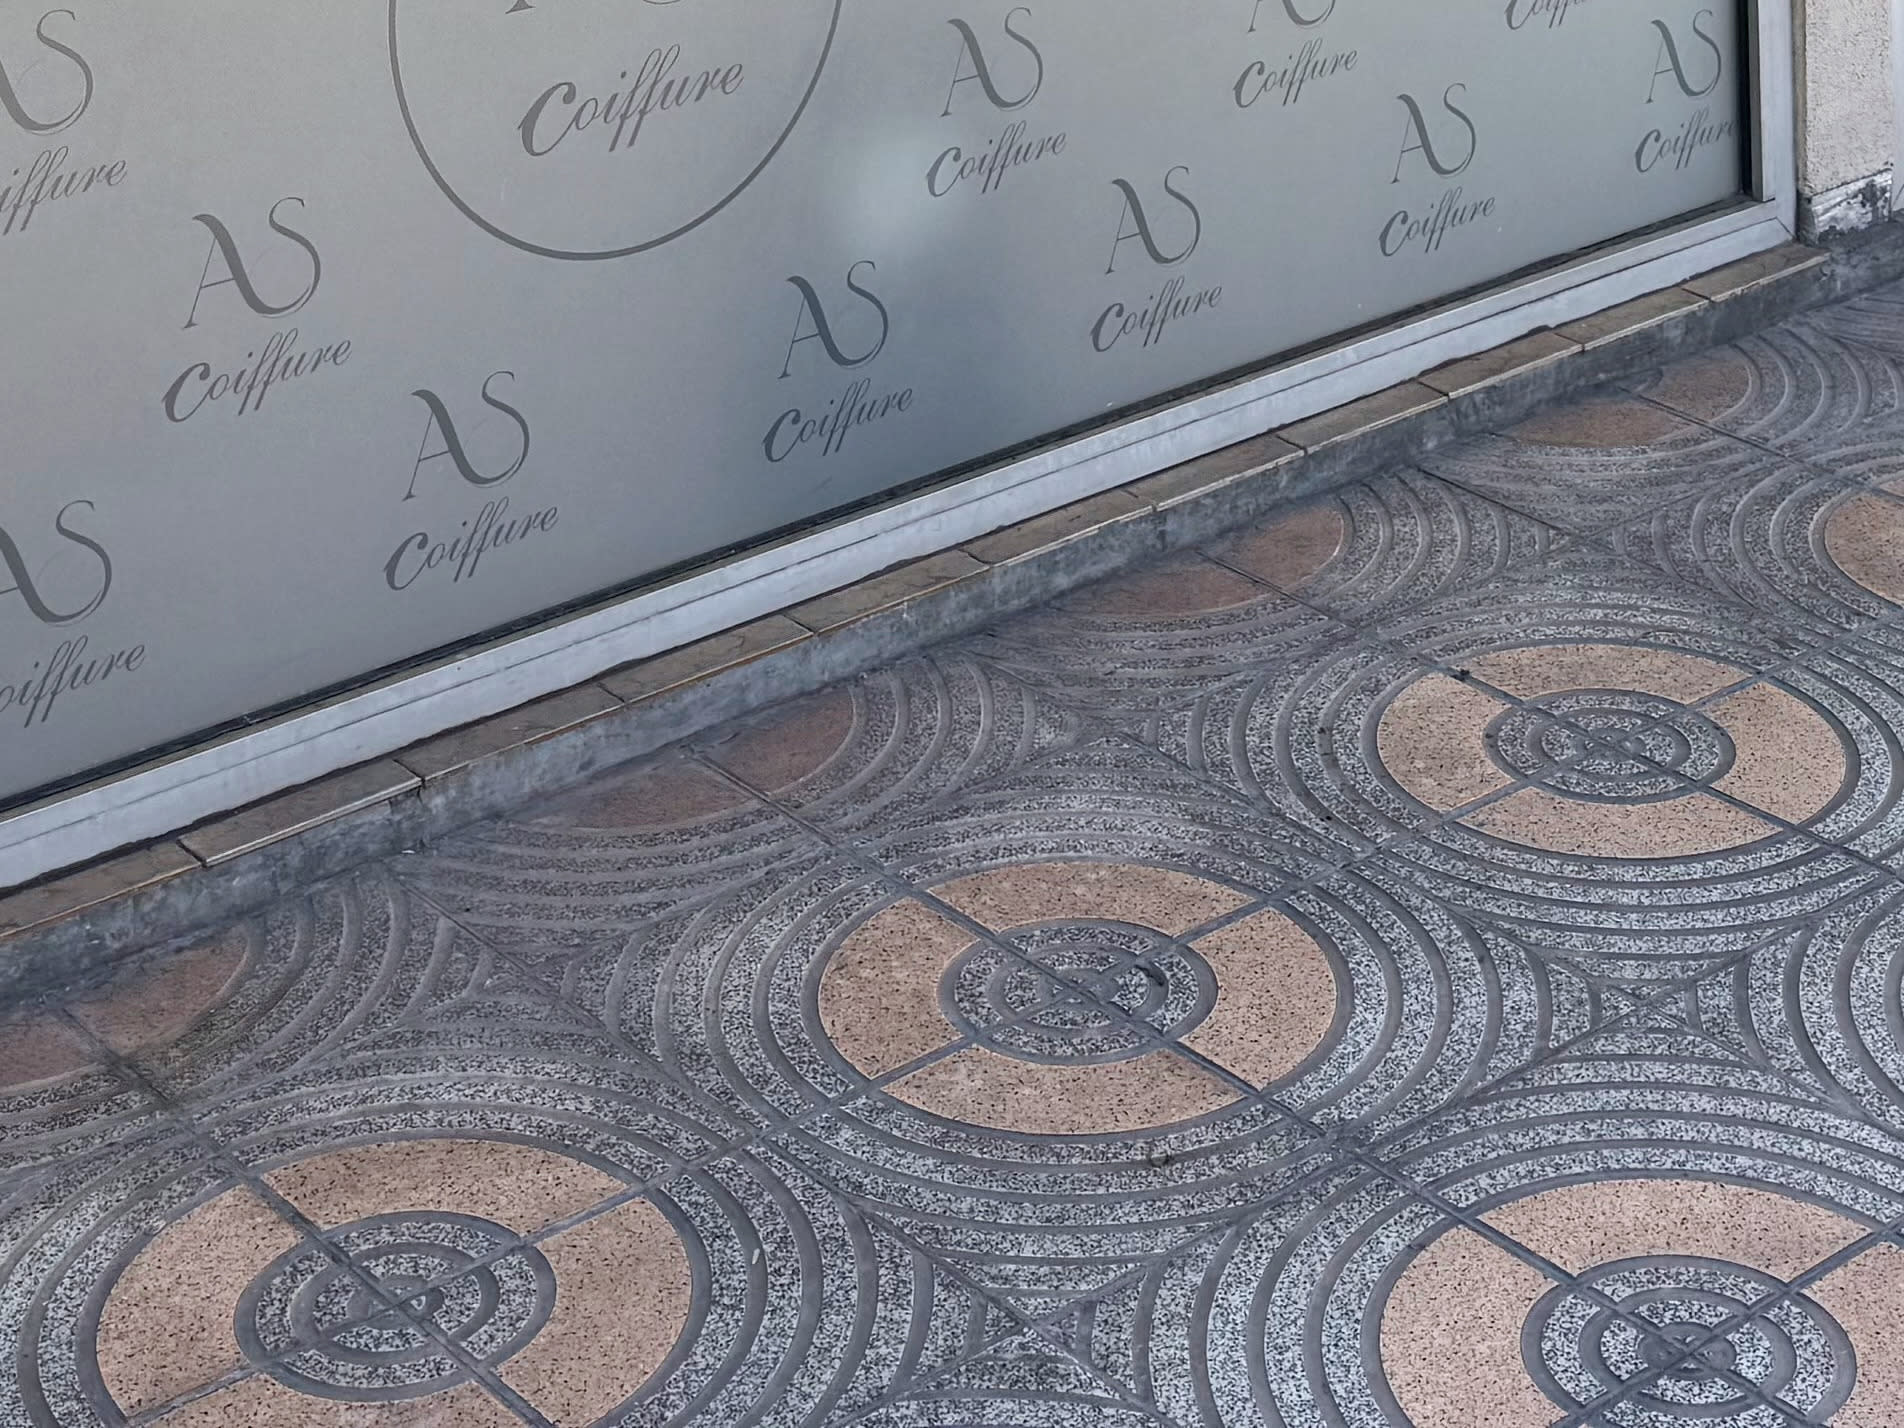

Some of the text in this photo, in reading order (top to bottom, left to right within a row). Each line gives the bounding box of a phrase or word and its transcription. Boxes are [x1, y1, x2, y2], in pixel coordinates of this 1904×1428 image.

[517, 44, 744, 157] Coiffure
[940, 7, 1043, 117] AS
[1232, 39, 1357, 109] Coiffure
[1646, 9, 1722, 104] AS
[926, 121, 1066, 197] Coiffure
[1391, 83, 1477, 184] AS
[182, 197, 321, 330] AS
[1105, 165, 1201, 275] AS
[1378, 187, 1495, 257] Coiffure
[778, 260, 889, 380] AS
[1090, 277, 1222, 353] Coiffure
[161, 328, 351, 423] Coiffure
[761, 378, 913, 463] Coiffure
[402, 371, 530, 502] AS
[383, 497, 558, 591] Coiffure
